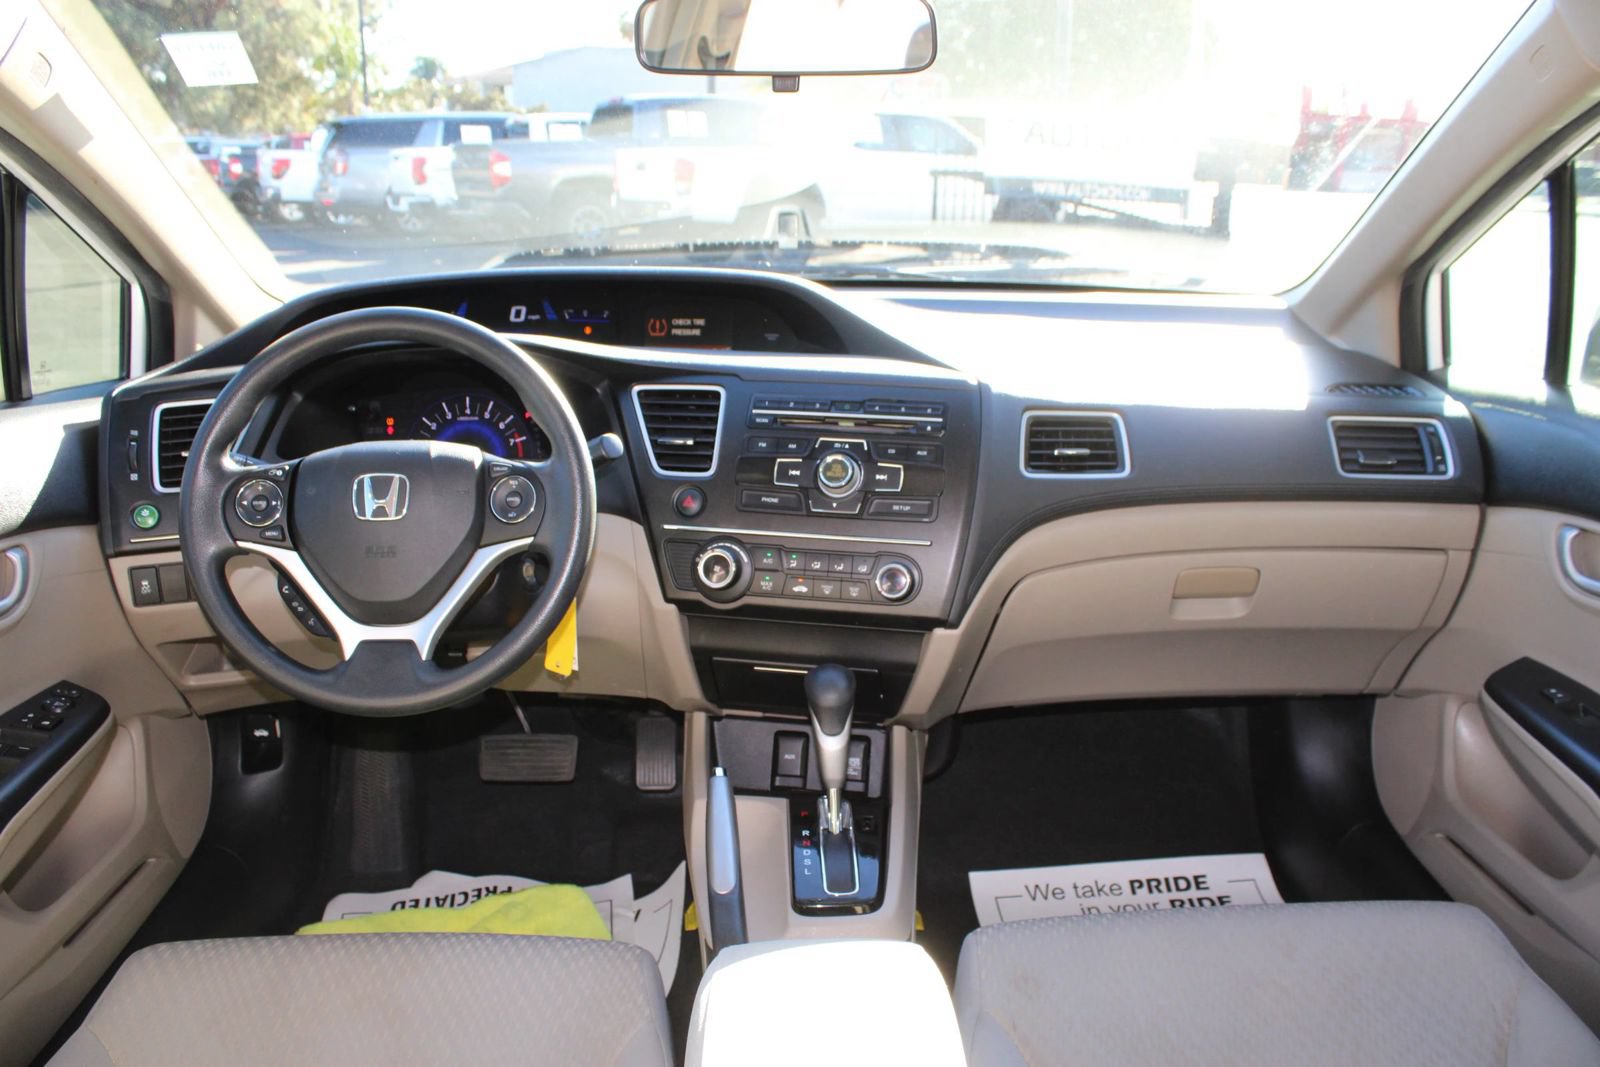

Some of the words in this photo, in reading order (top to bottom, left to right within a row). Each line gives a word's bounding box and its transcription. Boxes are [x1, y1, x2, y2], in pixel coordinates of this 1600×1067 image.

[509, 305, 527, 322] 0
[499, 421, 505, 430] 6
[761, 496, 779, 504] PHONE
[802, 829, 810, 837] R
[803, 858, 812, 866] S
[1024, 883, 1066, 901] We
[1072, 881, 1124, 899] take
[1128, 874, 1210, 896] PRIDE
